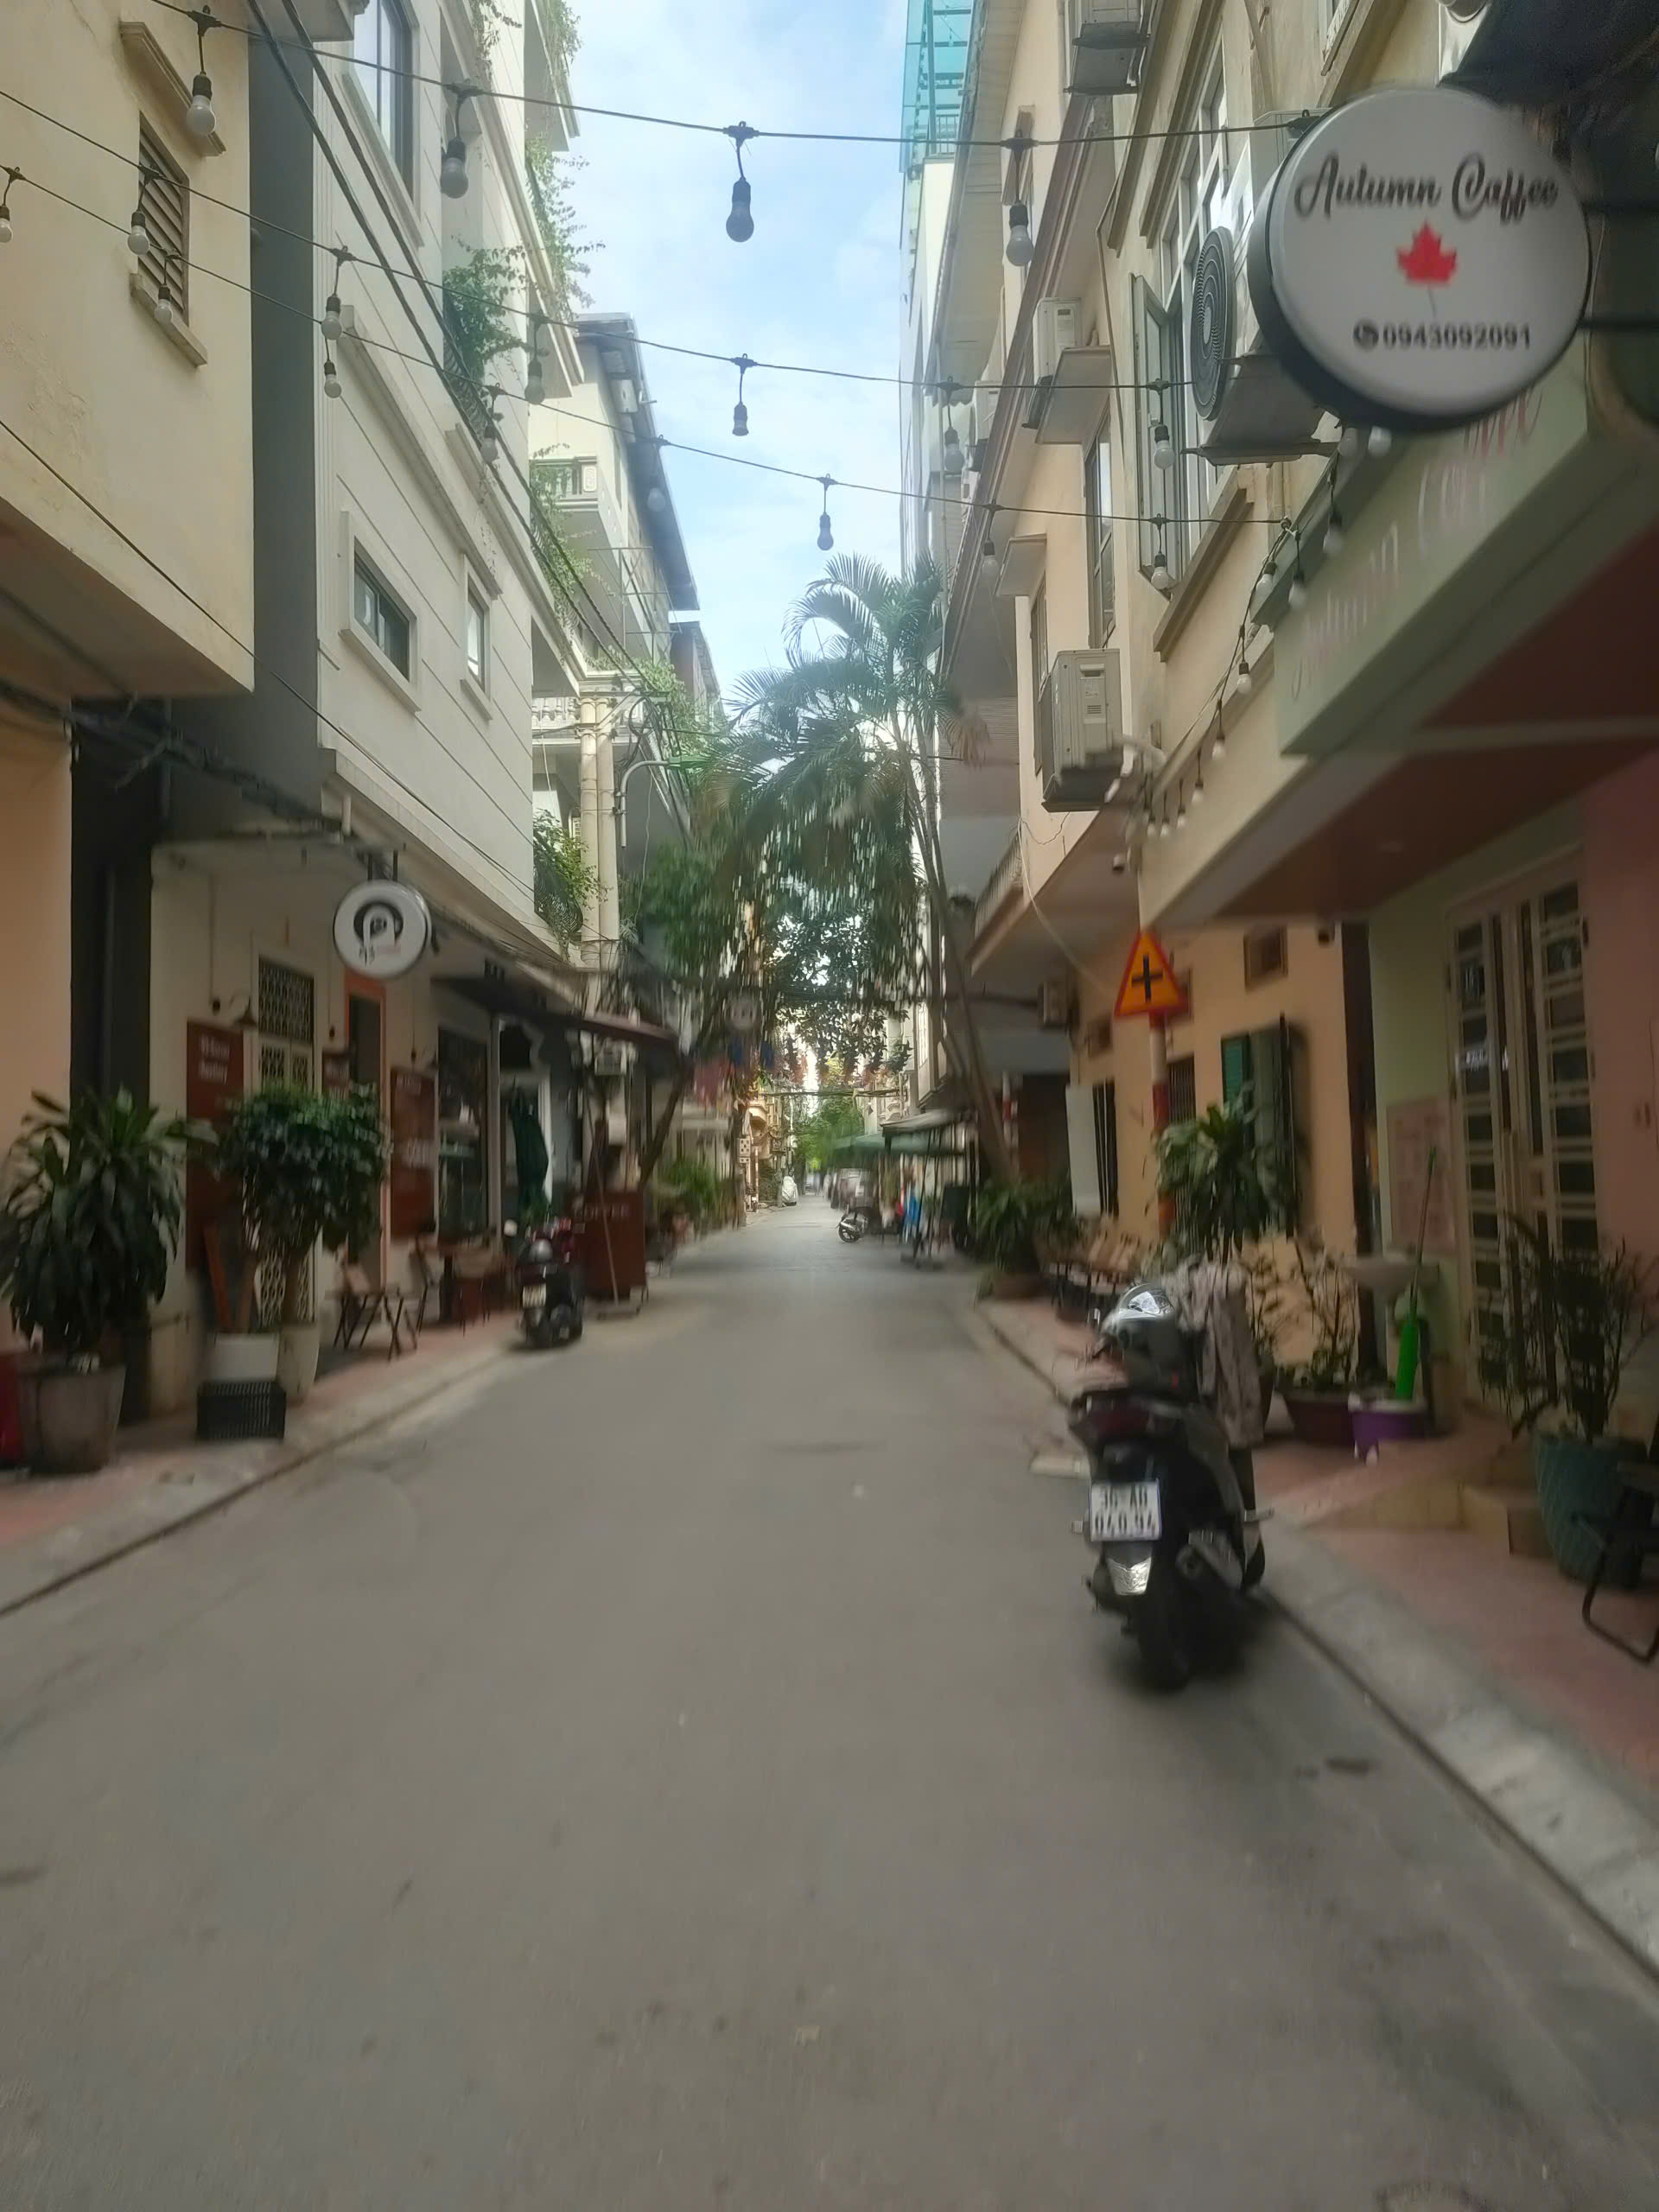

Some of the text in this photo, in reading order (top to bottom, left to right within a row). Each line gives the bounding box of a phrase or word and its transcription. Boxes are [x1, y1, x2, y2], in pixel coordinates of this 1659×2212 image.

[1295, 149, 1558, 224] Autumn Coffee
[1382, 321, 1532, 350] 0943092091
